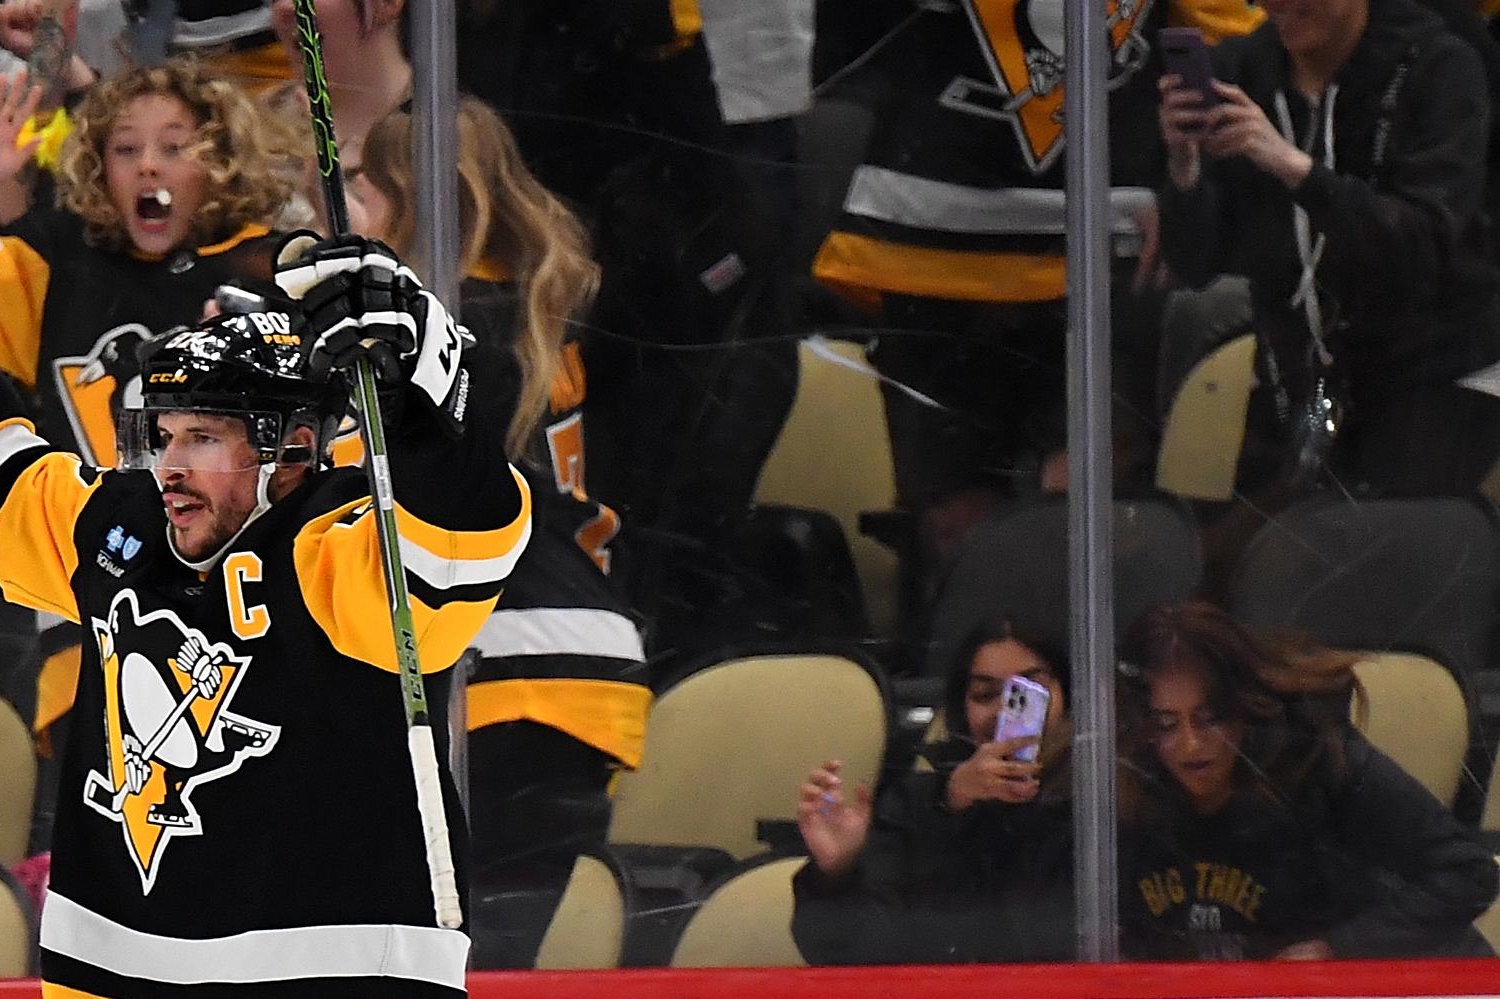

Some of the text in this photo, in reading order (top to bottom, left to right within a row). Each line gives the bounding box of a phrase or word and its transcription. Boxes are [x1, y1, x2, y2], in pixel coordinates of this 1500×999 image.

[149, 373, 189, 383] CCM
[222, 551, 272, 641] C
[401, 630, 423, 701] CCM
